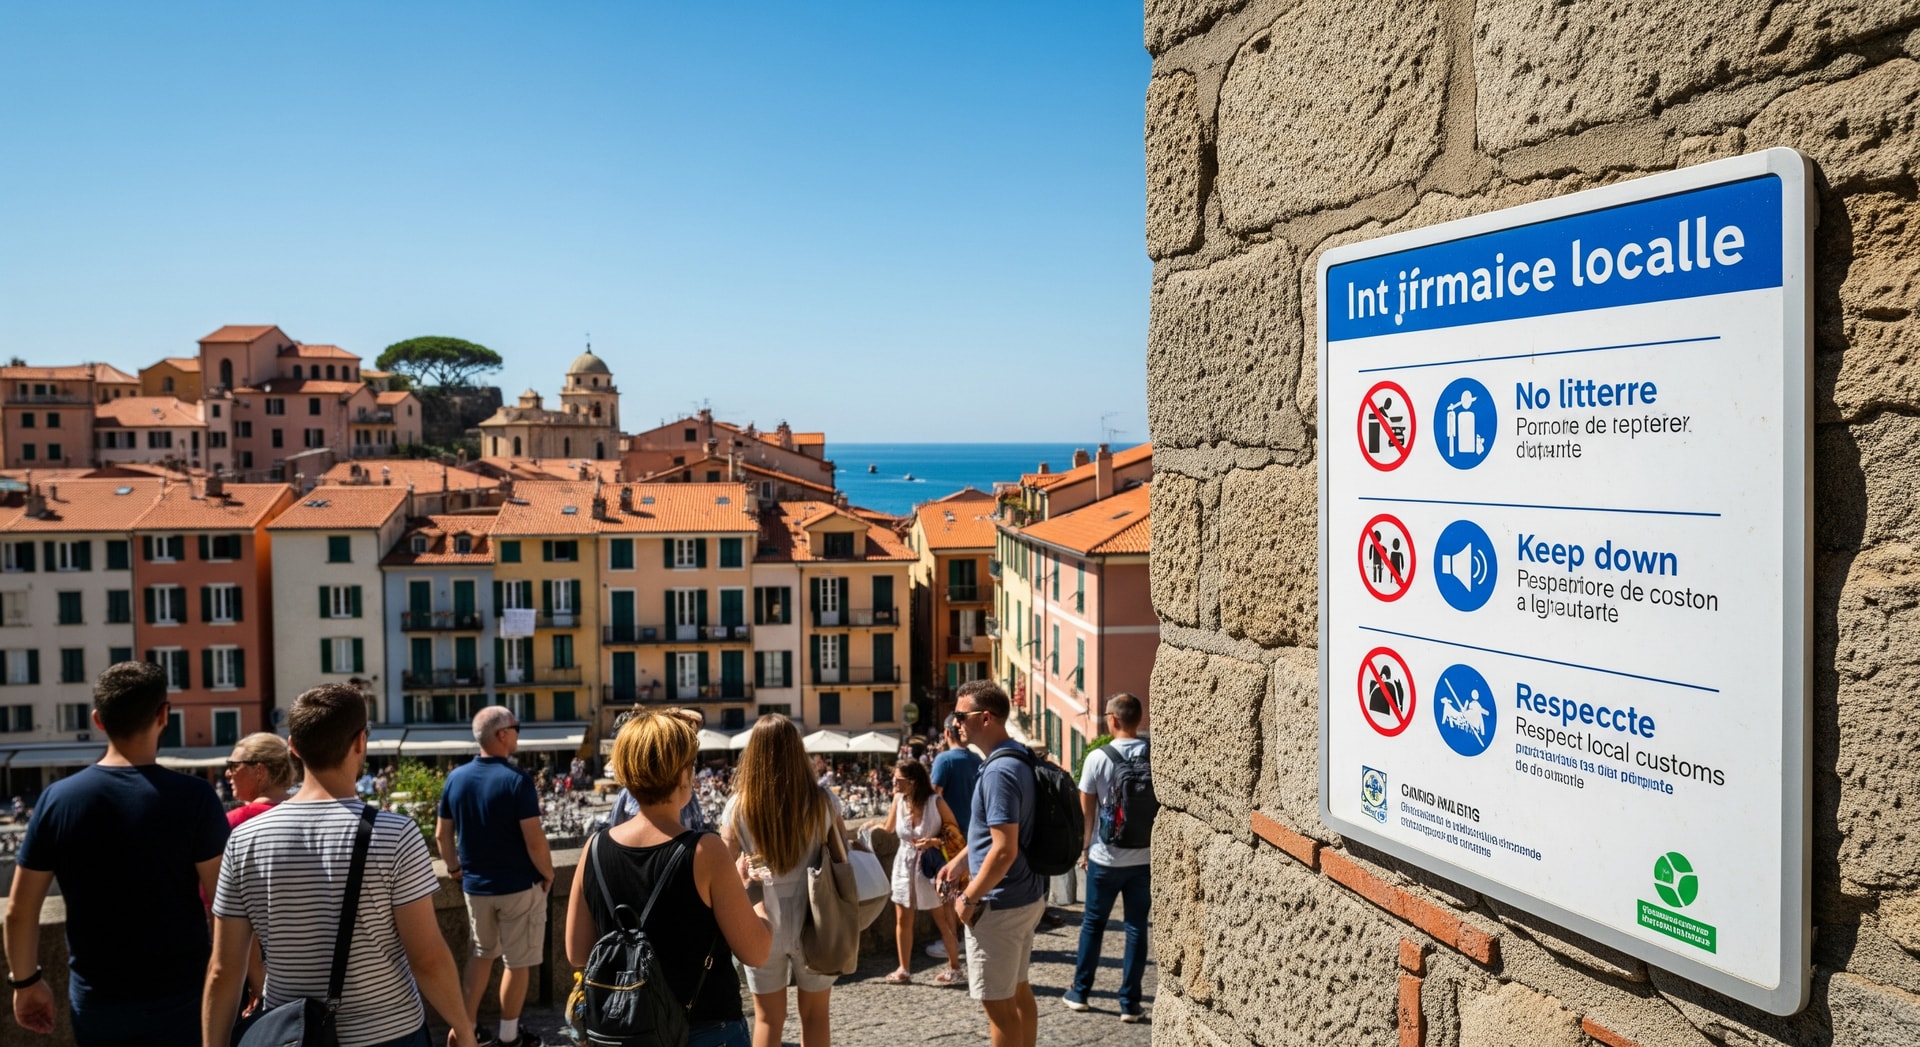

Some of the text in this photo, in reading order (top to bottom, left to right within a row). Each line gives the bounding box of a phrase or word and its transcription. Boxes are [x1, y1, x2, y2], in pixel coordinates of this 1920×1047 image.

[1348, 279, 1389, 320] Int
[1572, 215, 1746, 288] localle
[1515, 378, 1658, 410] No litterre
[1585, 415, 1607, 434] de
[1517, 533, 1678, 576] Keep down
[1516, 596, 1526, 611] a
[1620, 579, 1645, 601] de
[1649, 587, 1719, 611] coston
[1516, 682, 1656, 739] Respeccte
[1516, 716, 1583, 751] Respect
[1587, 733, 1630, 763] local
[1635, 750, 1726, 787] customs
